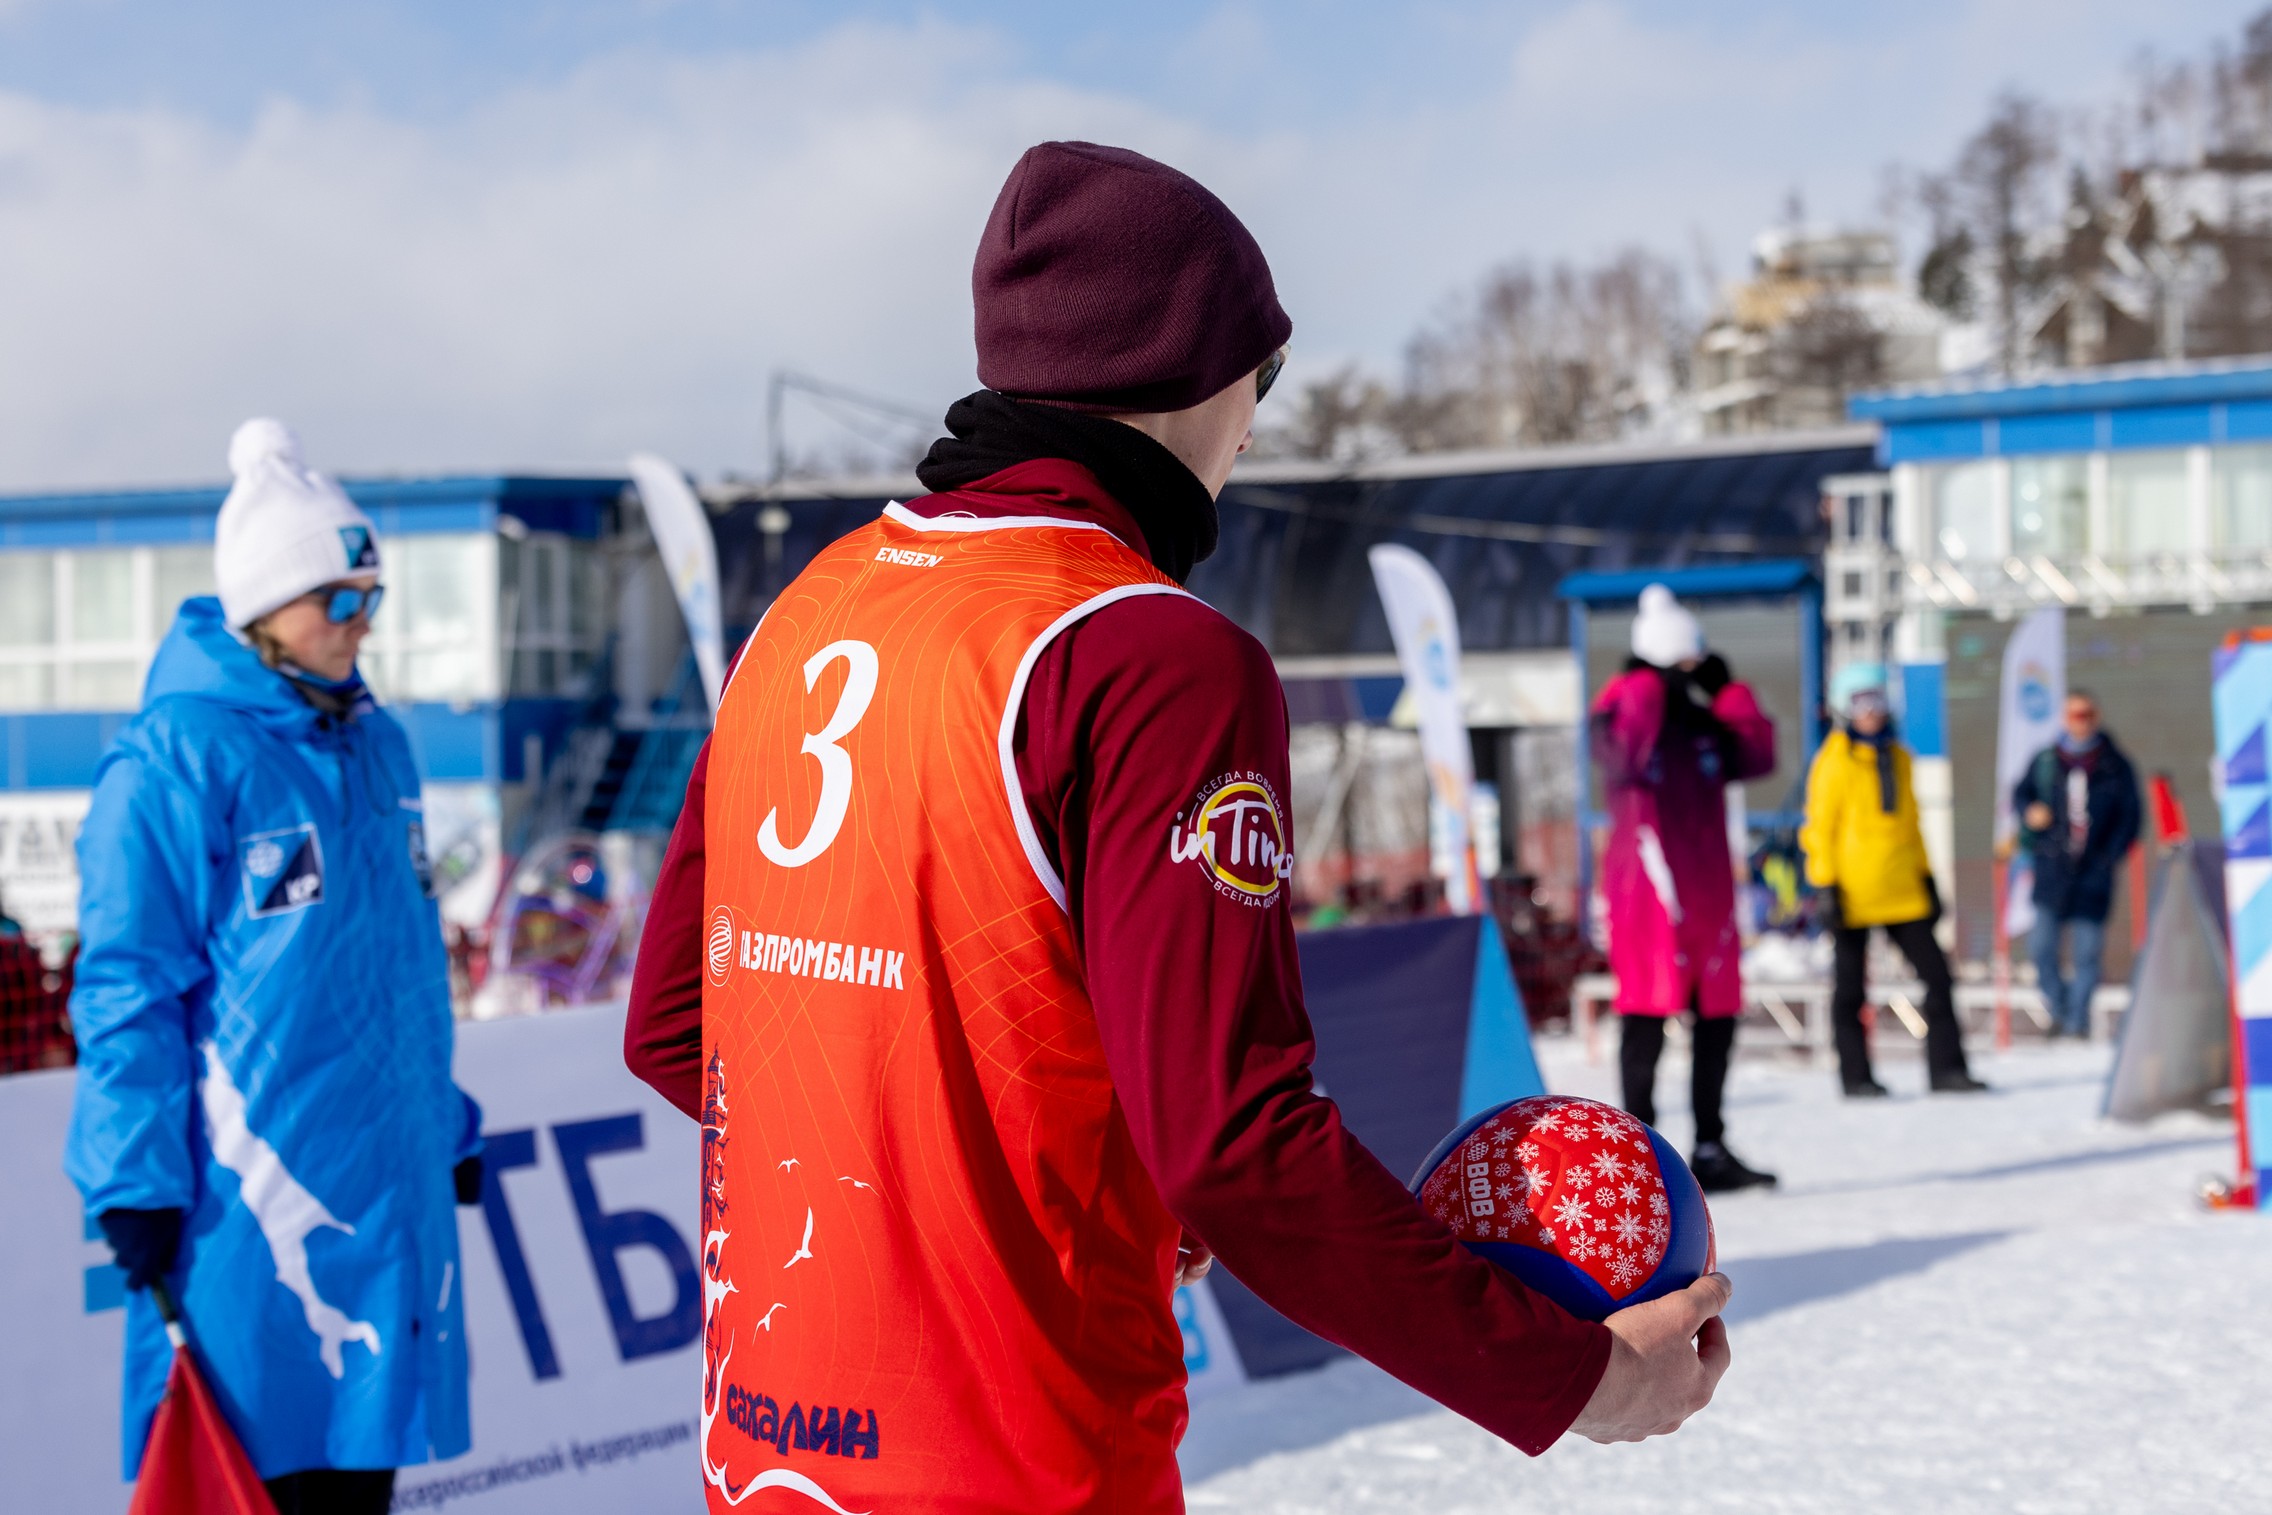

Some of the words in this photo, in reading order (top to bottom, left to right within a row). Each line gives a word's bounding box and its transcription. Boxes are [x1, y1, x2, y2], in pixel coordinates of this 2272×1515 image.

[874, 547, 944, 568] ENSEN
[757, 639, 879, 868] 3
[1197, 771, 1242, 802] ВСЕГДА
[1247, 770, 1284, 818] ВОВРЕМЯ
[1214, 880, 1262, 908] ВСЕГДА
[1467, 1162, 1495, 1217] ВФВ
